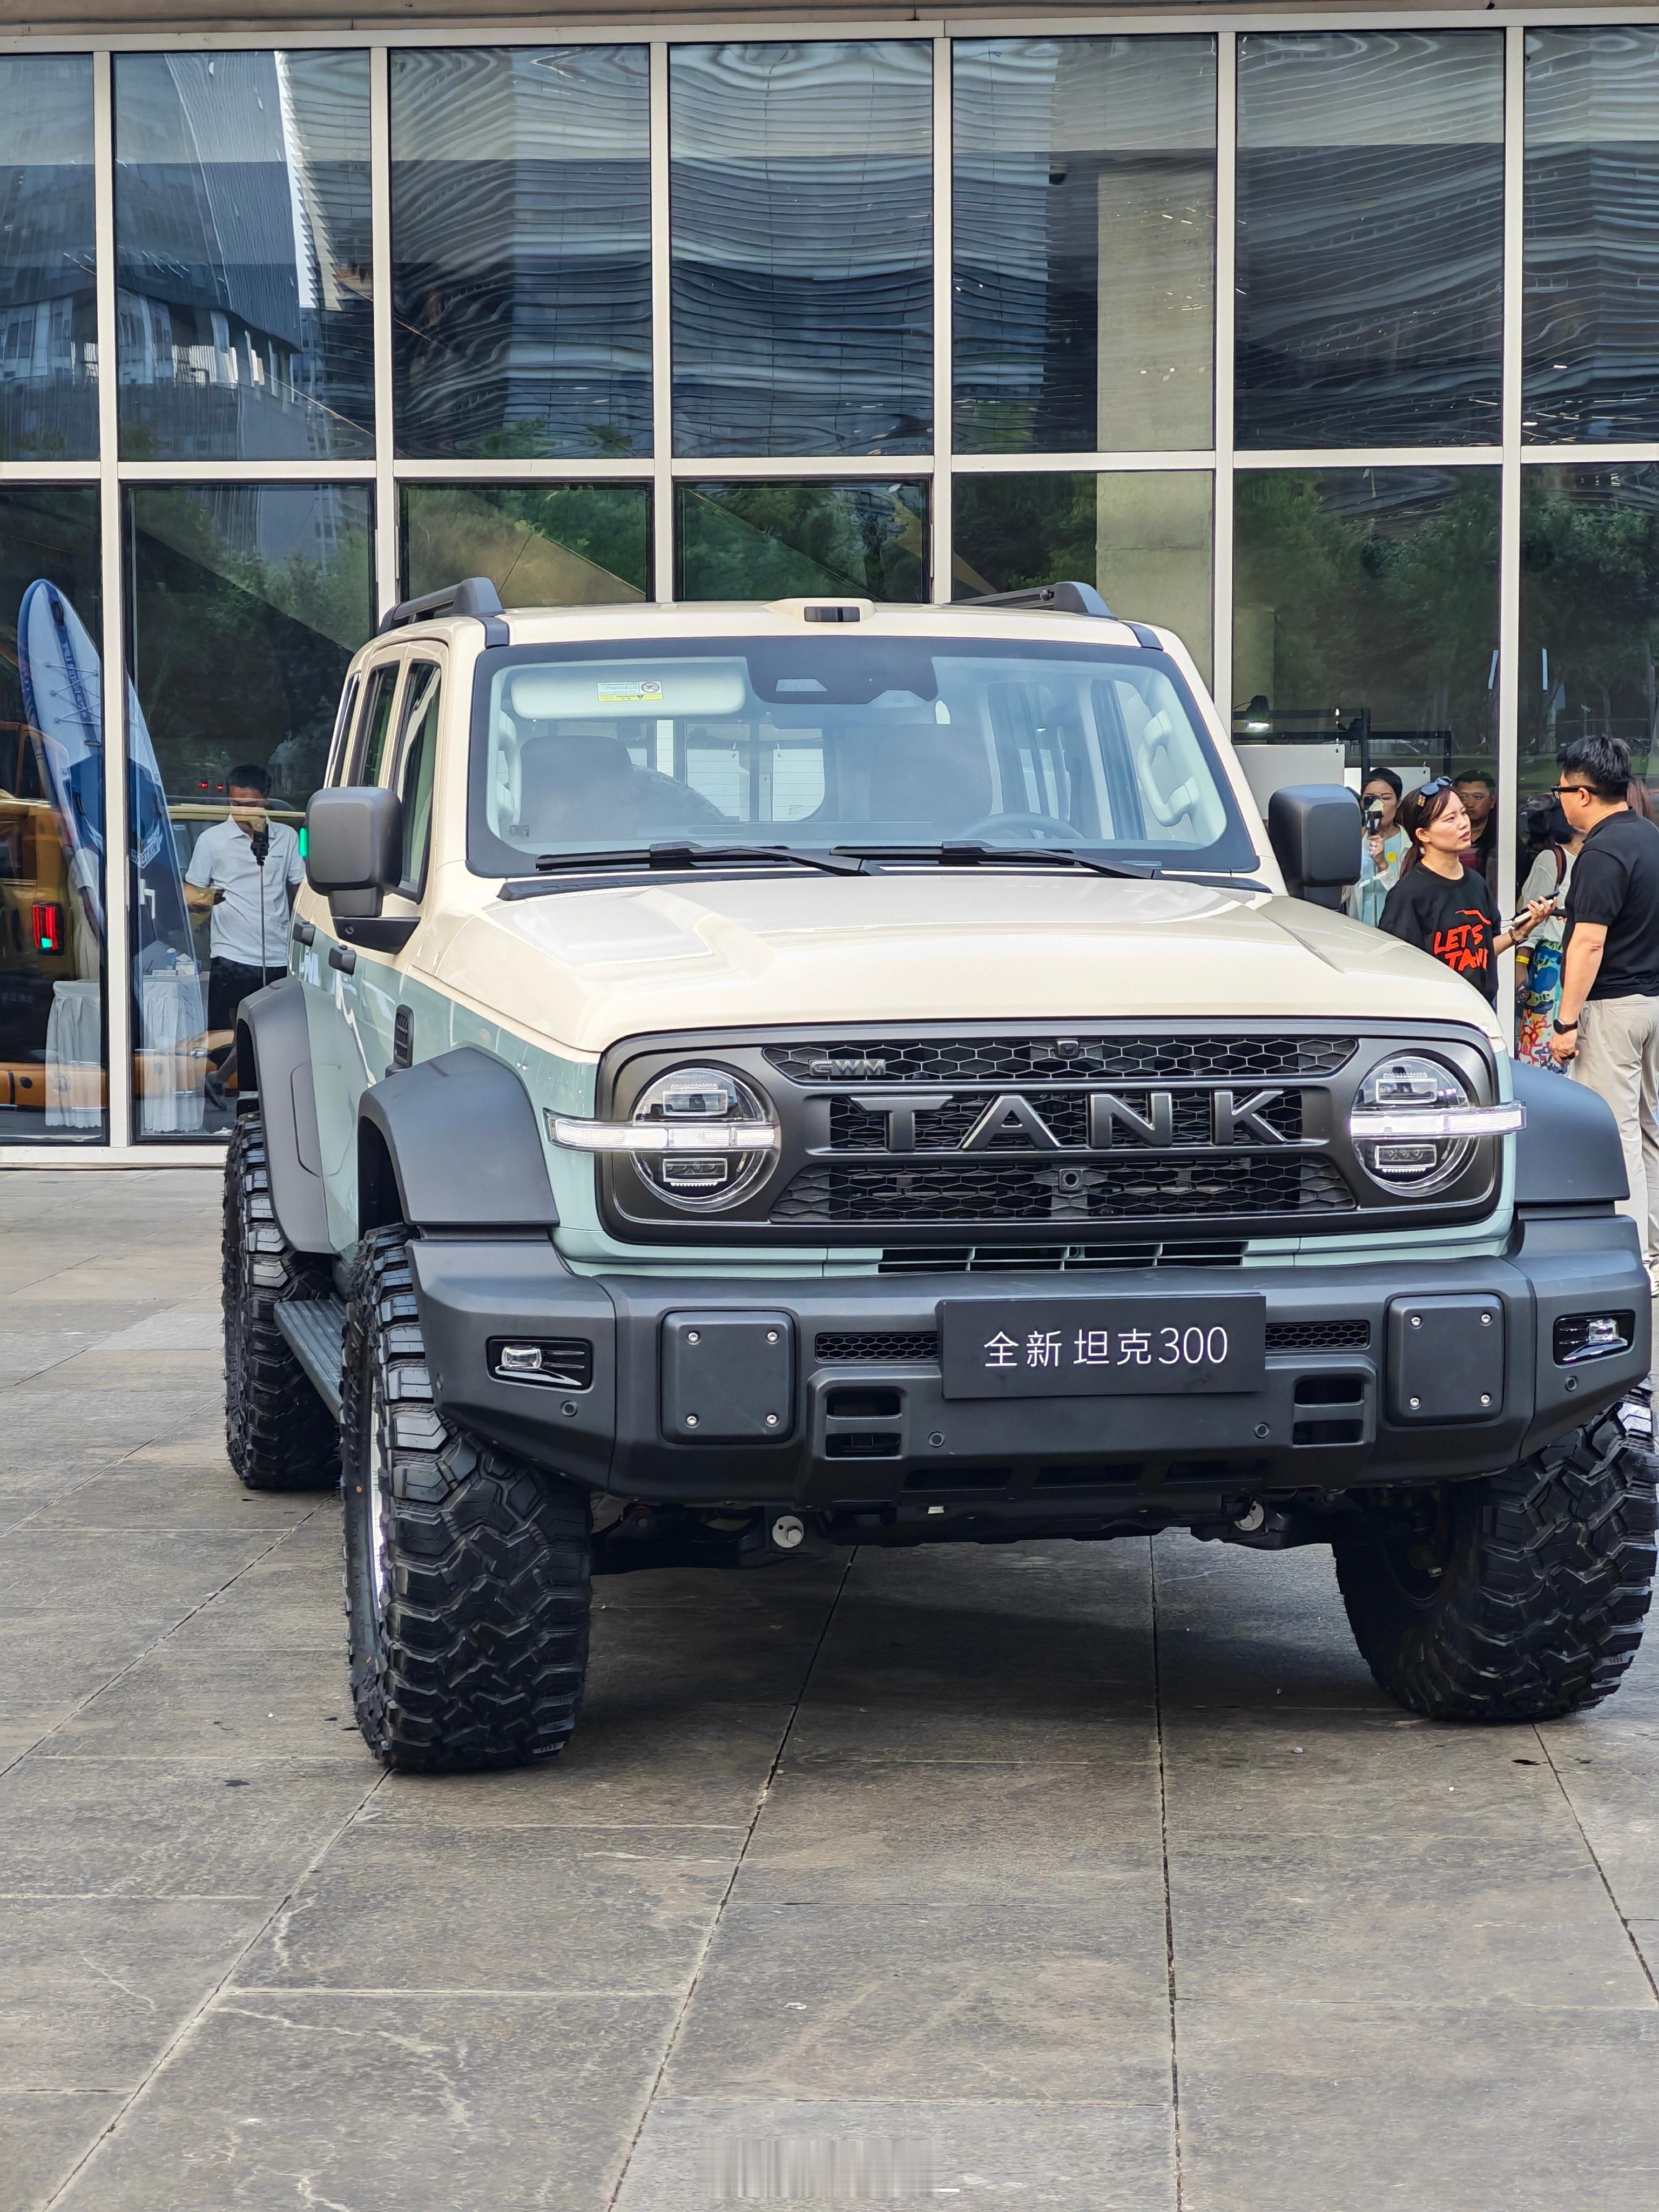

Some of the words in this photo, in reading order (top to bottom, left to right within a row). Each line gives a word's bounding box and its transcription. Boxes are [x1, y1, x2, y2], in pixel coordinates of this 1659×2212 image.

[1434, 924, 1483, 955] LETS
[810, 1060, 885, 1076] GWM
[849, 1089, 1287, 1153] TANK
[983, 1330, 1062, 1367] 全新
[1073, 1326, 1228, 1366] 坦克300
